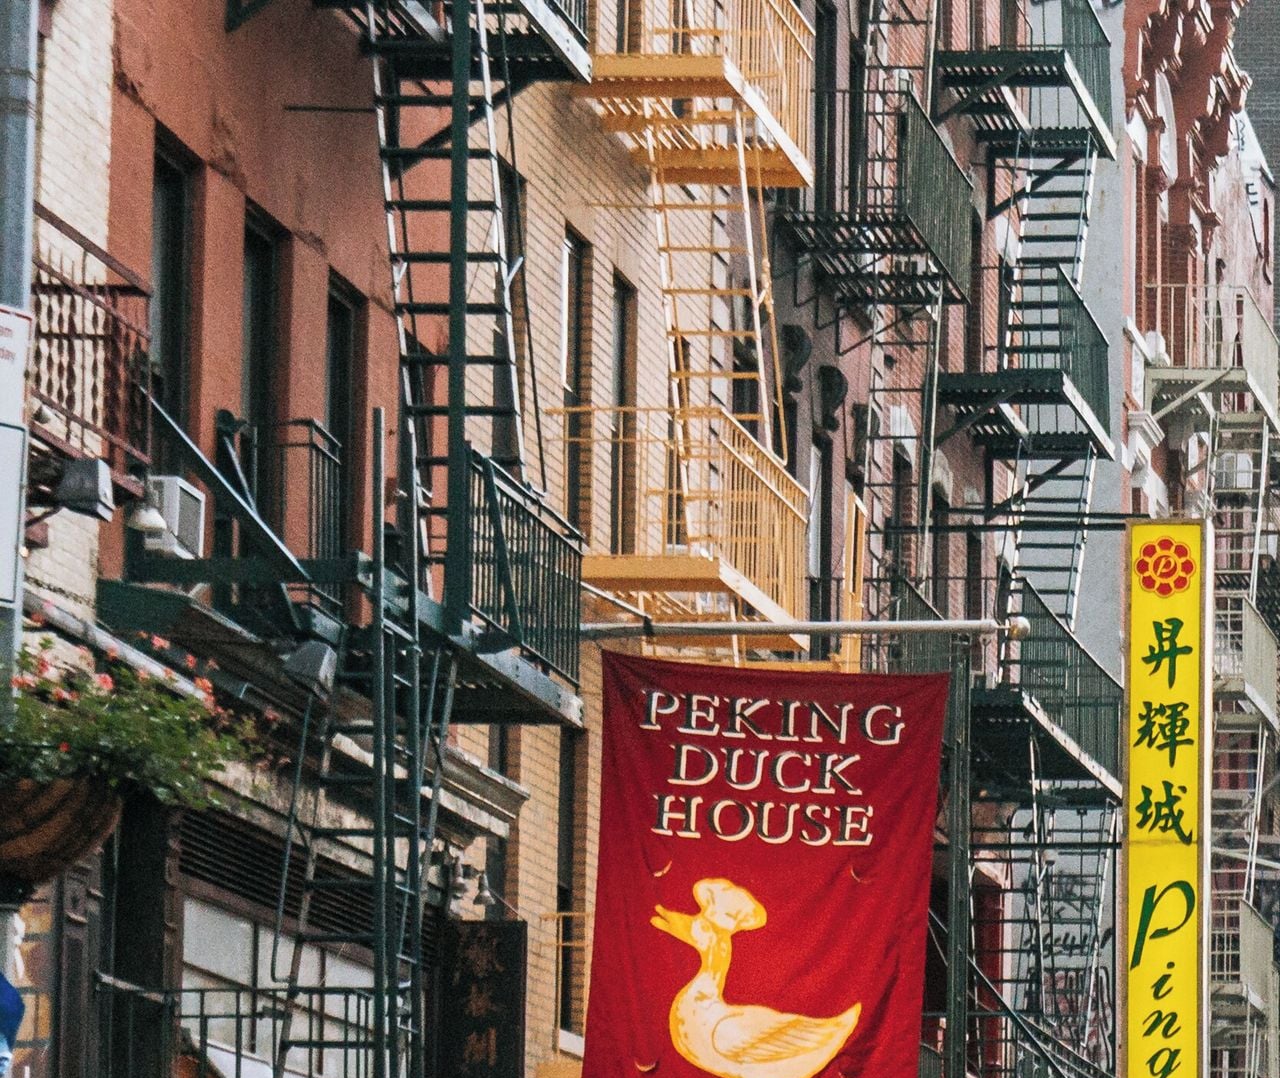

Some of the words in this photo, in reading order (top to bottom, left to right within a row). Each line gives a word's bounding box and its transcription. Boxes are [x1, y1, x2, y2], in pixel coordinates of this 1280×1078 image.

[640, 689, 905, 745] PEKING
[667, 743, 863, 795] DUCK
[650, 793, 874, 846] HOUSE
